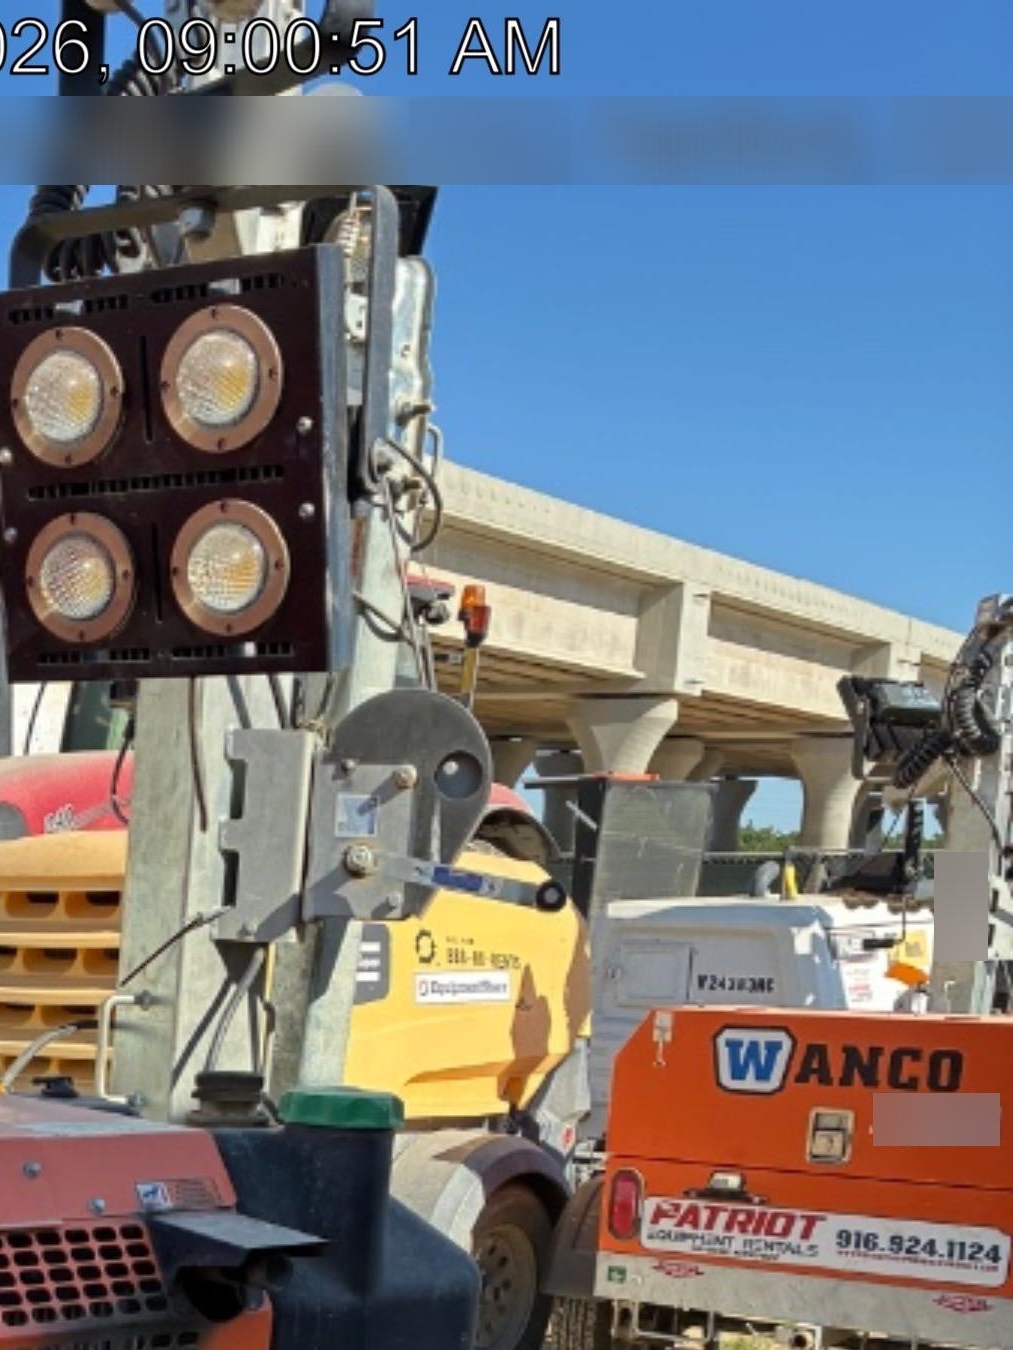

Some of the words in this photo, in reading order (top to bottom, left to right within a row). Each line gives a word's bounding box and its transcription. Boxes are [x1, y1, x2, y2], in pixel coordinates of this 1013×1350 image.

[724, 1036, 965, 1093] WANCO
[649, 1201, 828, 1241] PATRIOT
[646, 1229, 736, 1249] EQUIPMENT
[742, 1238, 820, 1258] RENTALS
[835, 1229, 1003, 1264] 916.924.1124
